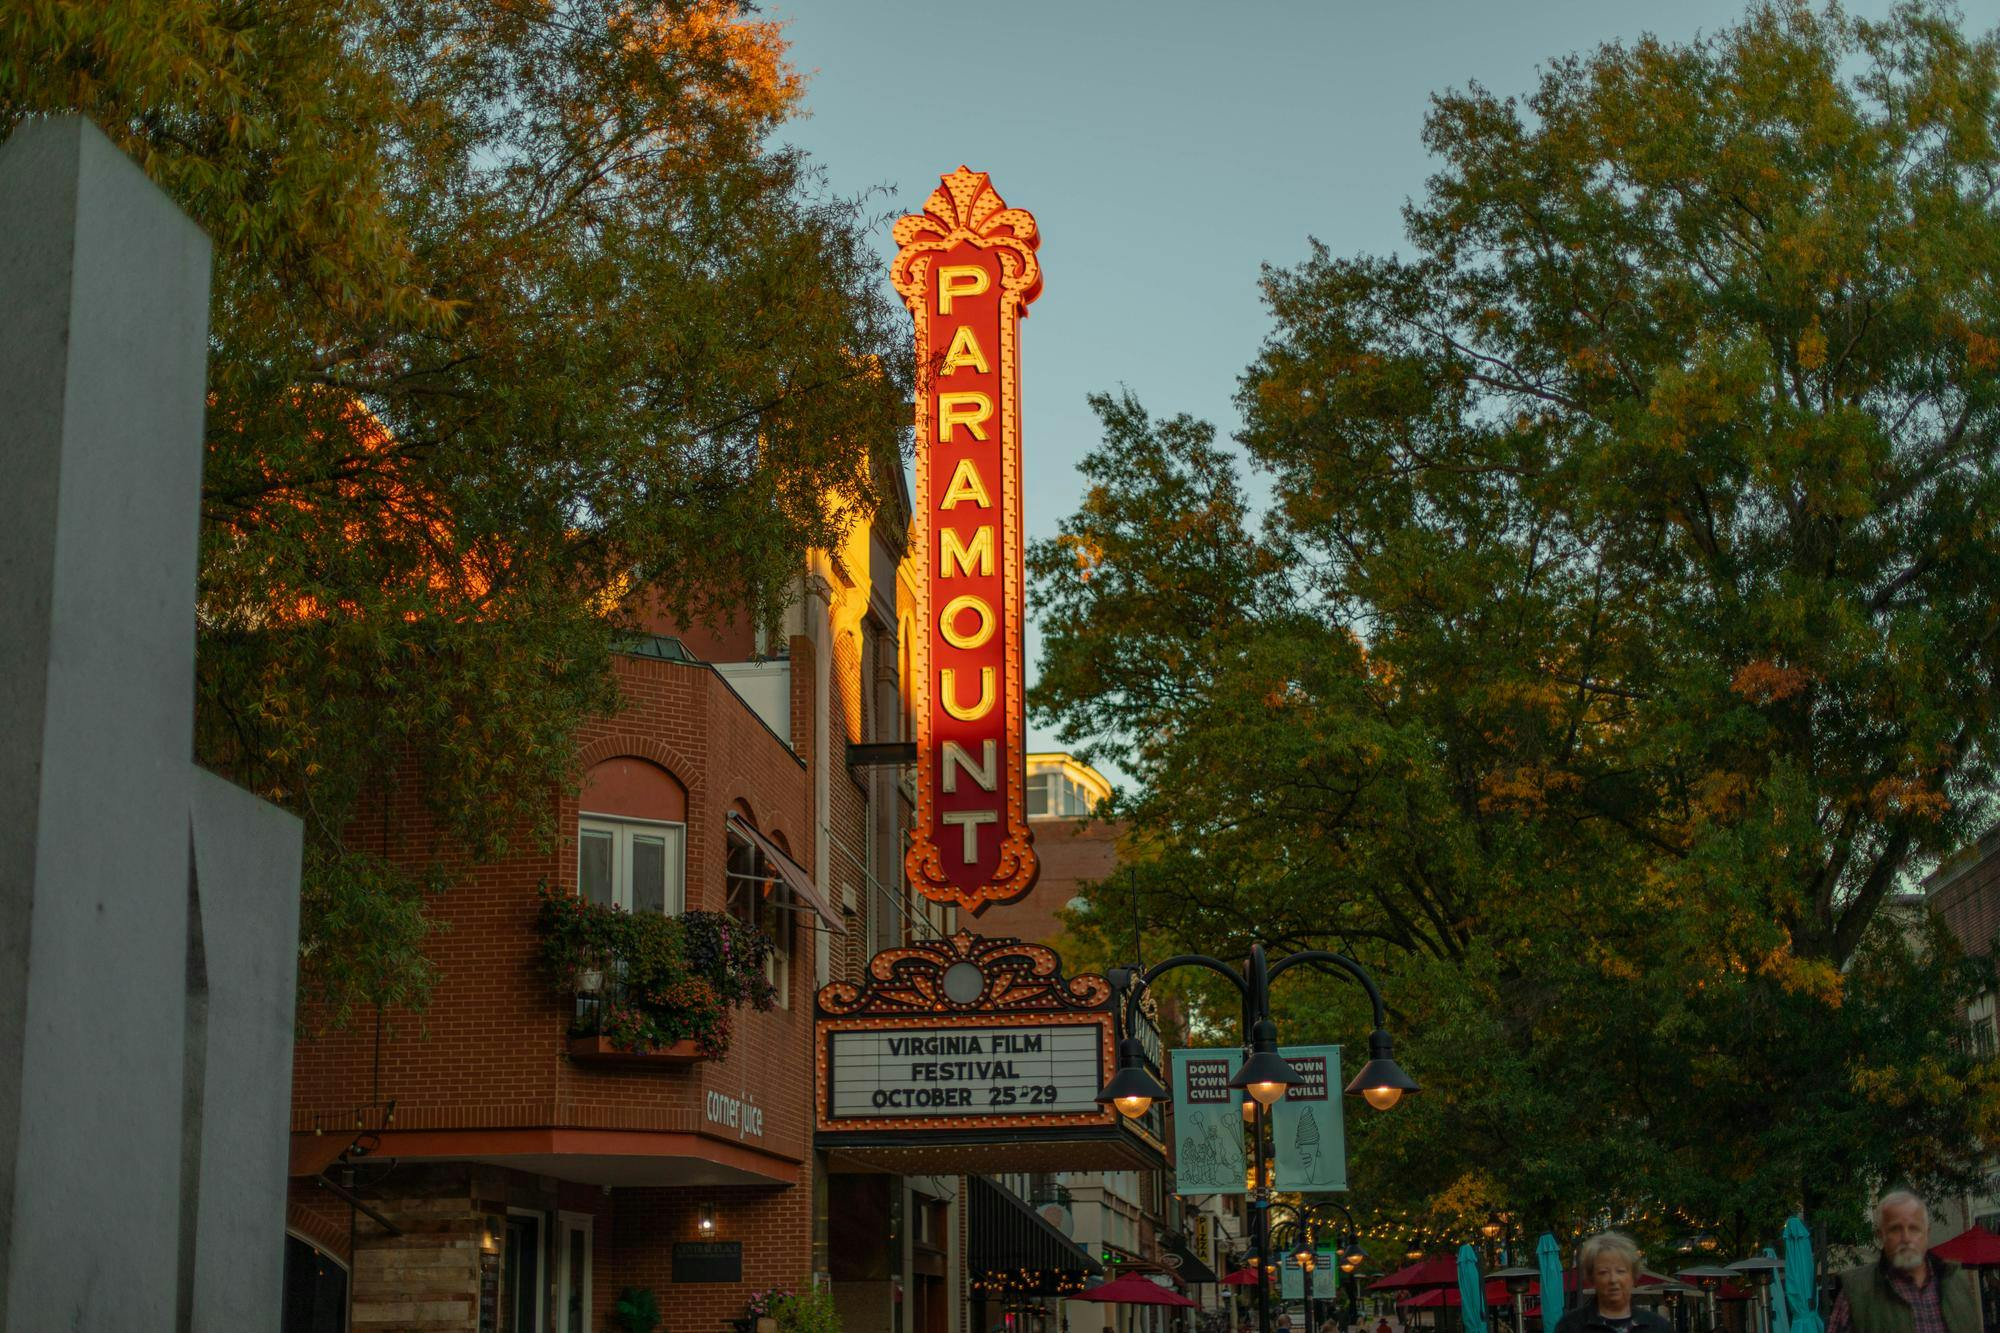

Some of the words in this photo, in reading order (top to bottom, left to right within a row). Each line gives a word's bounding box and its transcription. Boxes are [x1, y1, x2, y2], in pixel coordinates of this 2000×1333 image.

[938, 264, 998, 865] PARAMOUNT
[887, 1035, 983, 1057] VIRGINIA
[991, 1033, 1043, 1055] FILM
[911, 1060, 1020, 1082] FESTIVAL
[1189, 1064, 1226, 1074] DOWN
[1298, 1073, 1325, 1084] WN
[1190, 1077, 1227, 1086] TOWN
[1288, 1086, 1325, 1097] CVILLE
[871, 1087, 972, 1109] OCTOBER
[1190, 1089, 1227, 1099] CVILLE
[706, 1089, 740, 1129] corner
[740, 1091, 763, 1140] juice
[1199, 1217, 1208, 1259] PIZZA
